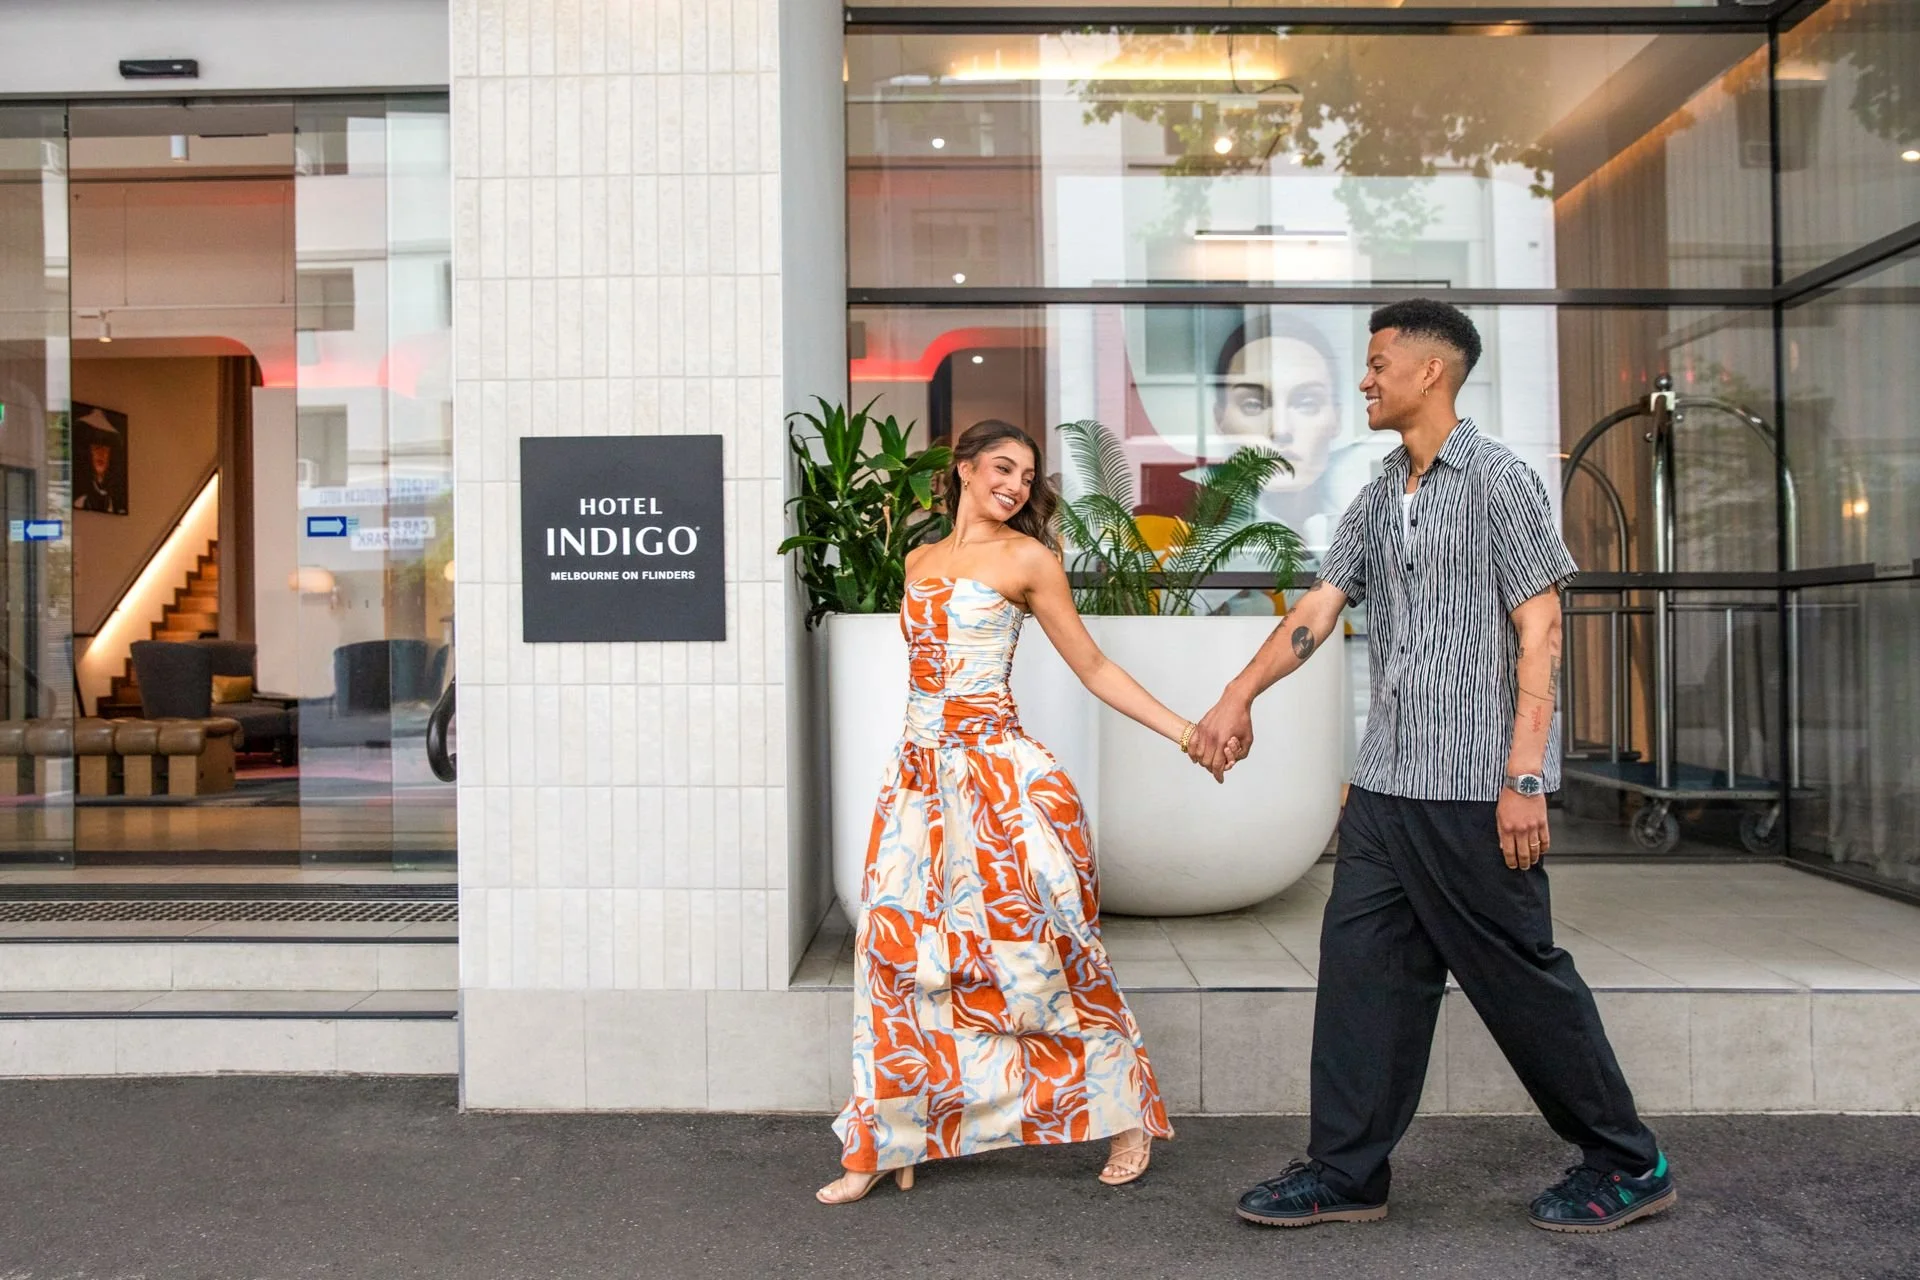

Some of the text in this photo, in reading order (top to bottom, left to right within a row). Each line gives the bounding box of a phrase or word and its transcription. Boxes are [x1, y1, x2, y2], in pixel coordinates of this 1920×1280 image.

[579, 497, 663, 516] HOTEL
[546, 526, 700, 557] INDIGO
[551, 570, 696, 581] MELBOURNE ON FLINDERS
